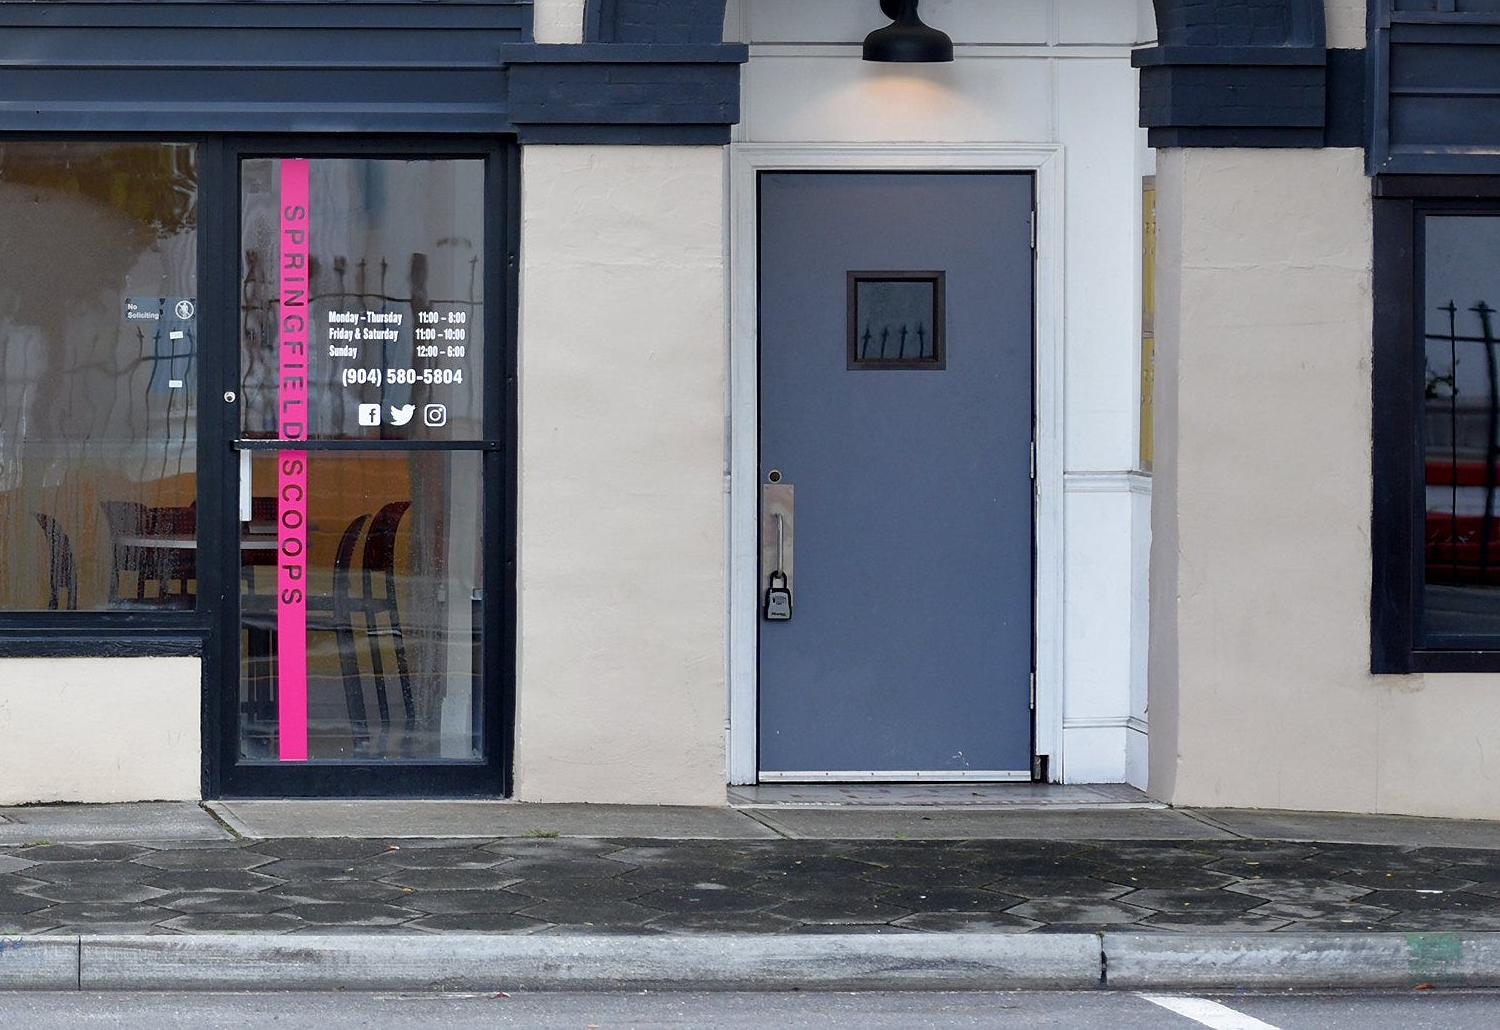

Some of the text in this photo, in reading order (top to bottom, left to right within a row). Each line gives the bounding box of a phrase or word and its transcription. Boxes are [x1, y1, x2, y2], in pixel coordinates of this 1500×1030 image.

[127, 311, 160, 320] Soliciting
[328, 311, 359, 325] Monday
[366, 311, 402, 325] Thursday
[418, 311, 439, 323] 11:00
[448, 311, 466, 323] 8:00
[328, 328, 353, 342] Friday
[354, 328, 361, 340] &
[363, 328, 399, 342] Saturday
[415, 328, 436, 340] 11:00
[444, 328, 466, 340] 10:00
[329, 345, 357, 359] Sunday
[416, 345, 438, 357] 12:00
[447, 345, 466, 357] 6:00
[342, 368, 463, 387] (904) 580-5804
[281, 205, 305, 606] SPRINGFIELD SCOOPS
